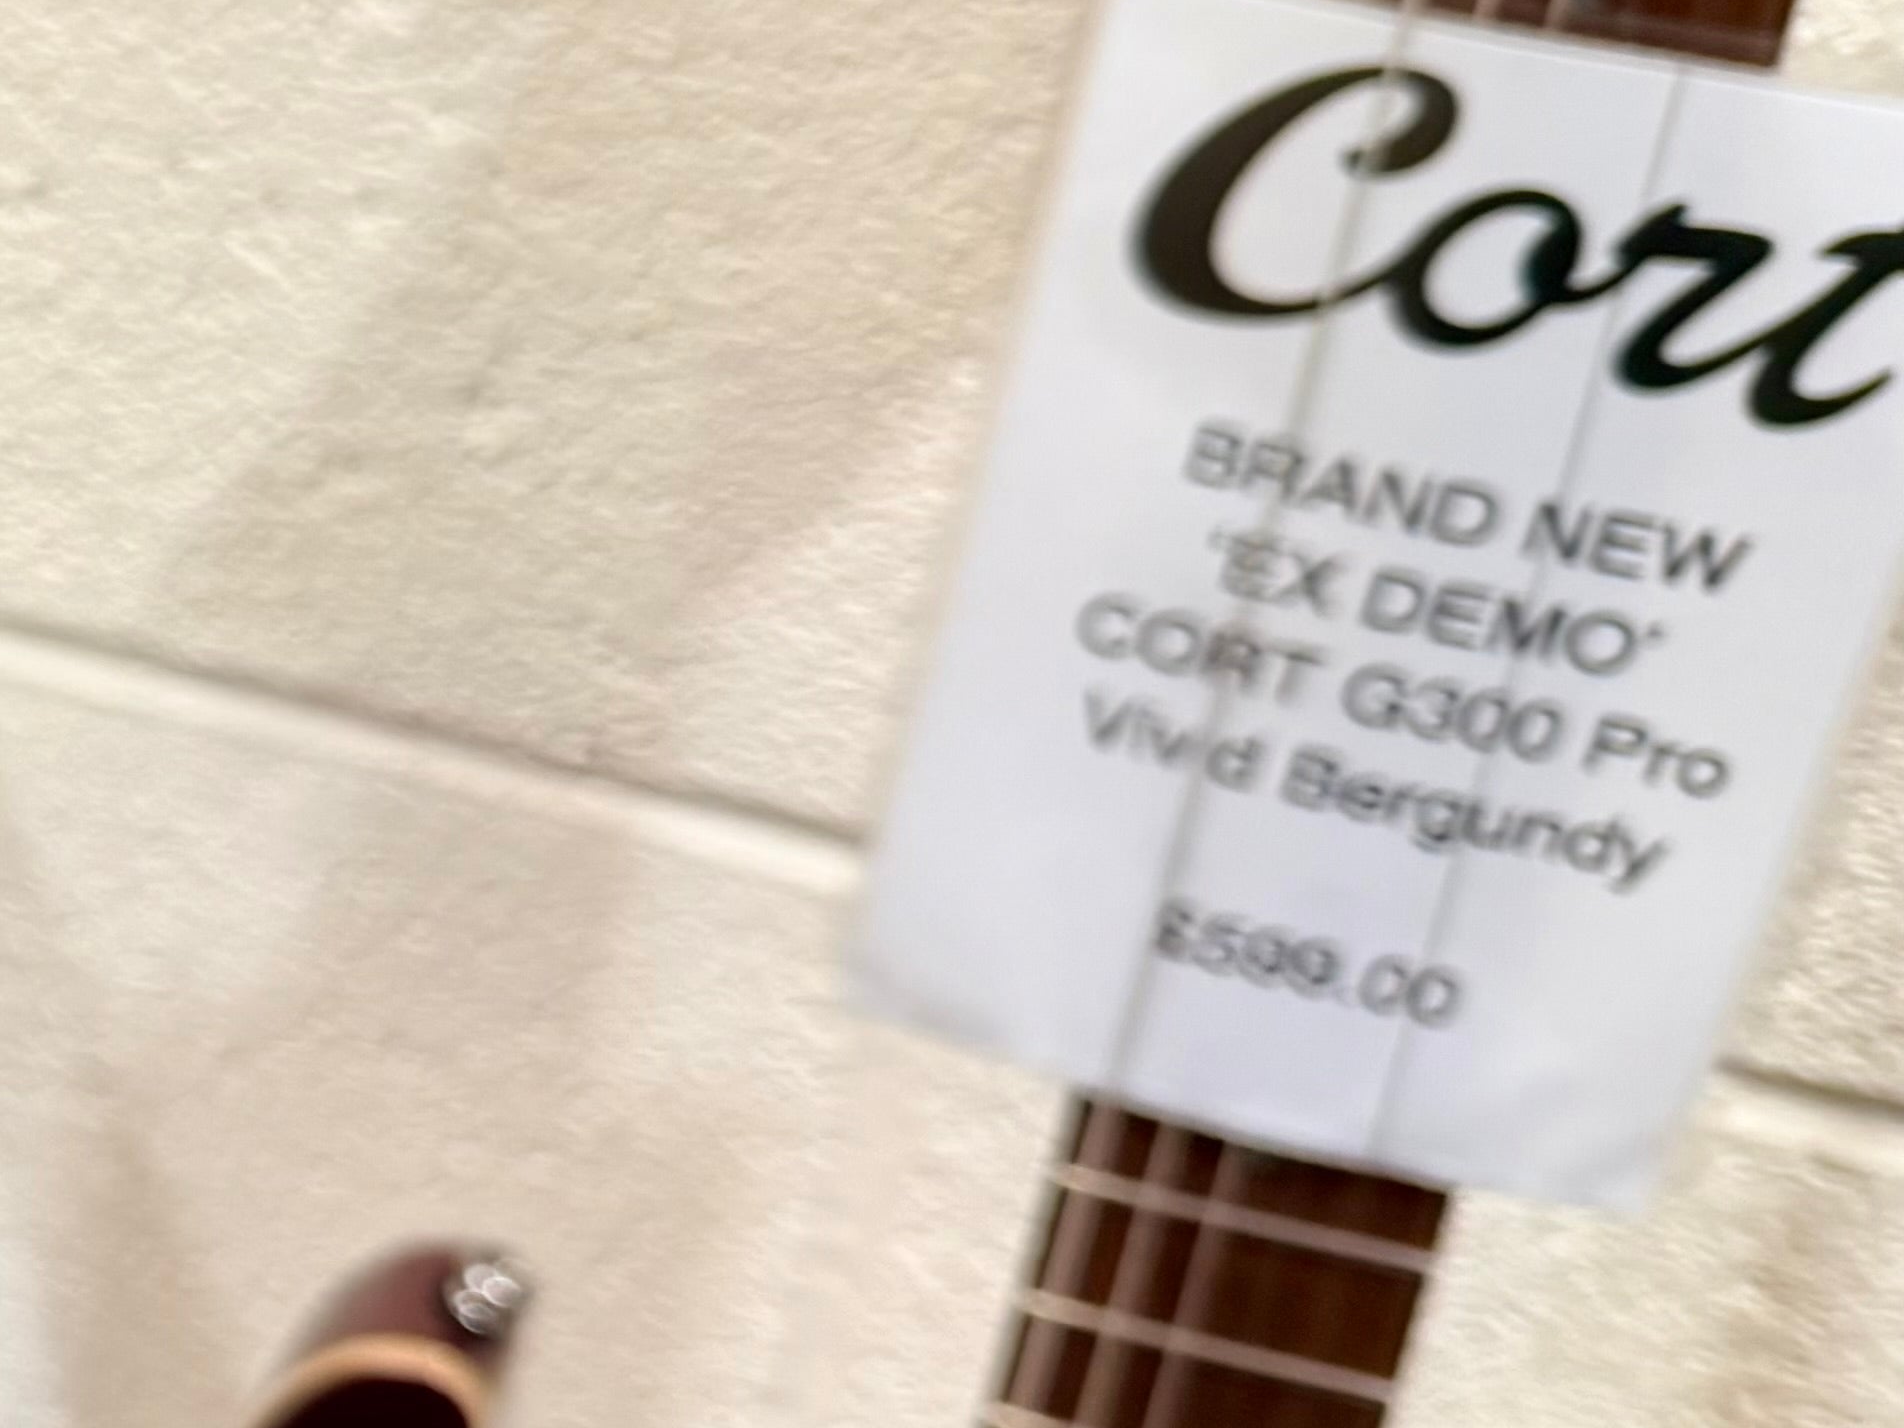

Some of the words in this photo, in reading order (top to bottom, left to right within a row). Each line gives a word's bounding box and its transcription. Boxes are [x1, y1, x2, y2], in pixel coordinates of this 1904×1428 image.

[1132, 63, 1904, 430] Cort
[1187, 422, 1498, 548] BRAND
[1522, 497, 1754, 596] NEW
[1074, 590, 1324, 708] CORT
[1340, 662, 1566, 766] G300
[1582, 712, 1734, 802] Pro
[1278, 744, 1669, 894] Bergundy
